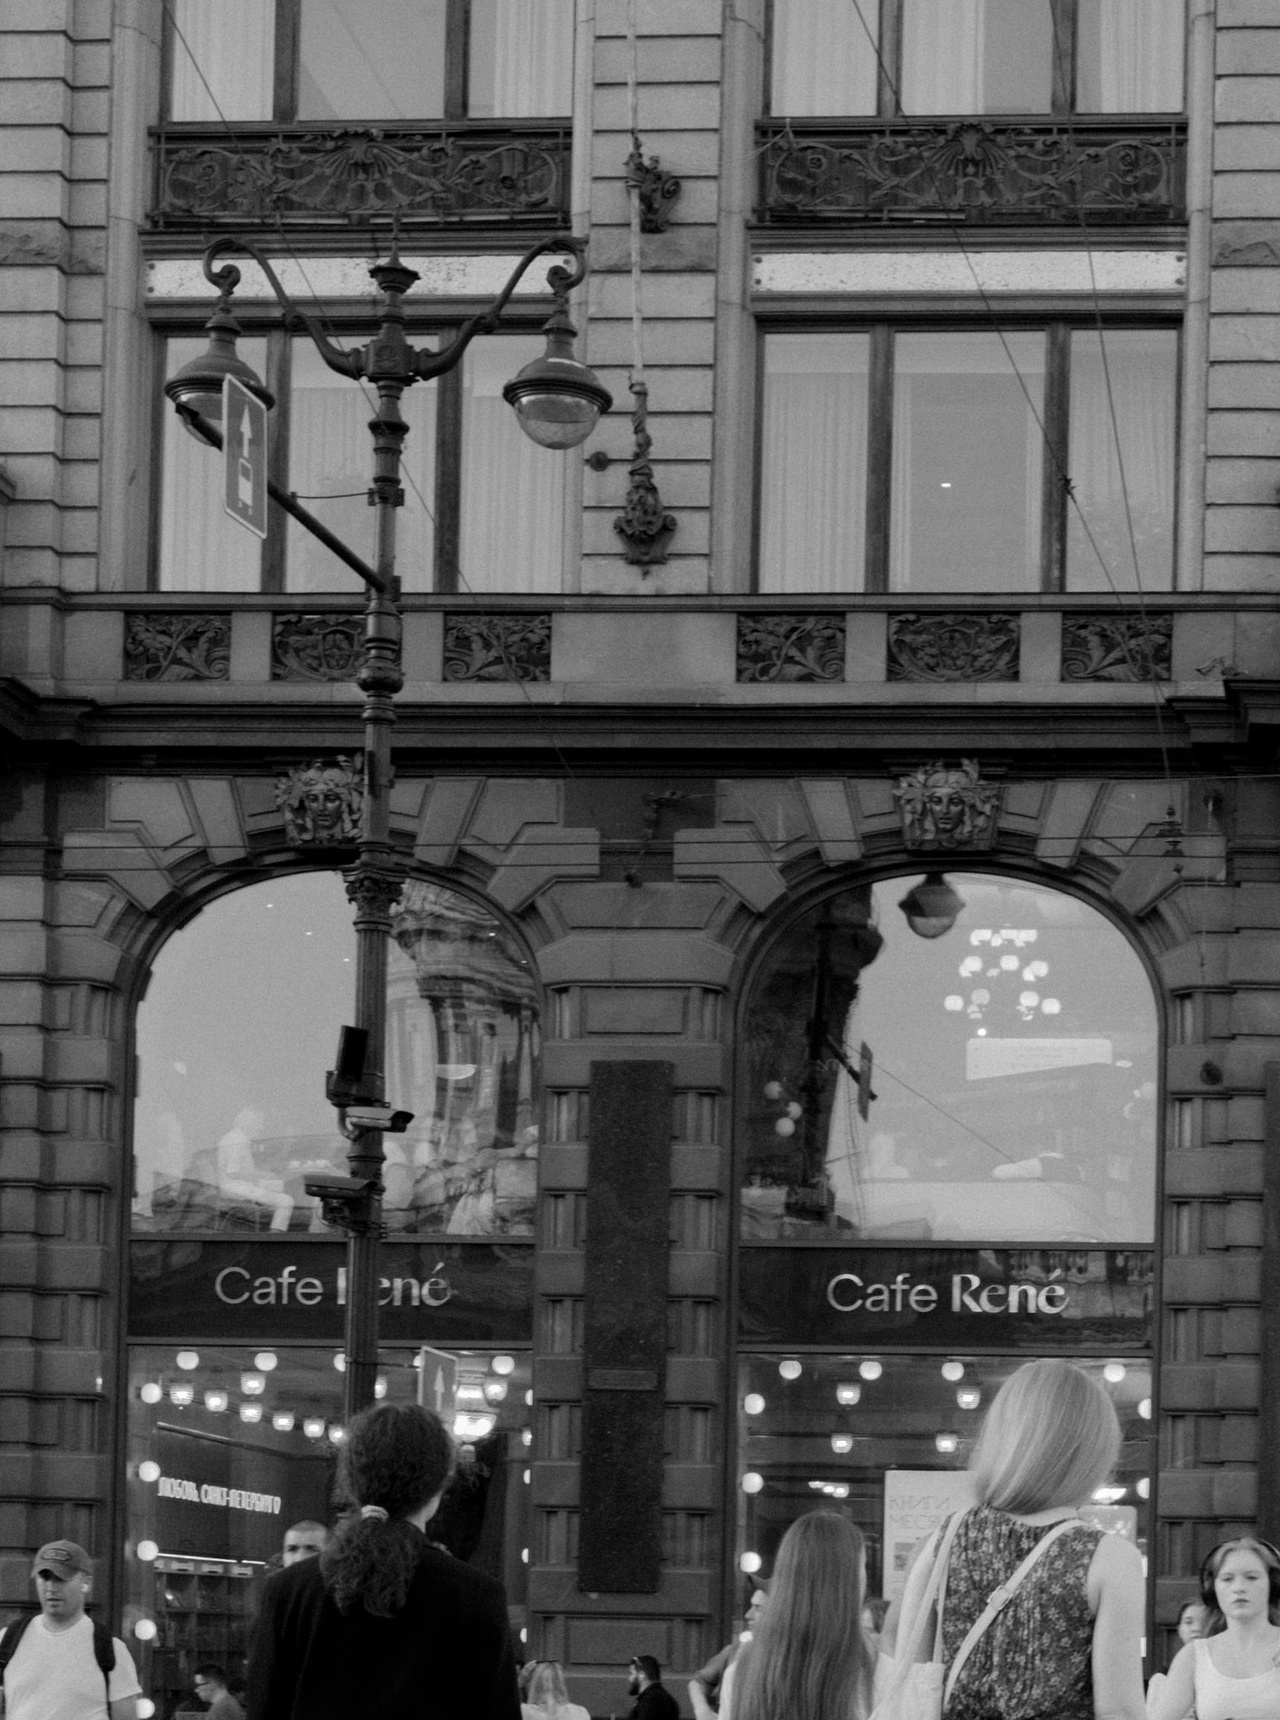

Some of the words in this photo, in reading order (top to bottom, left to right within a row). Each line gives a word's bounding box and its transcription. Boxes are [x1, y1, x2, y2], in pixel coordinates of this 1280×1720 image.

[215, 1265, 324, 1305] Cafe
[827, 1273, 938, 1313] Cafe
[951, 1268, 1071, 1314] René
